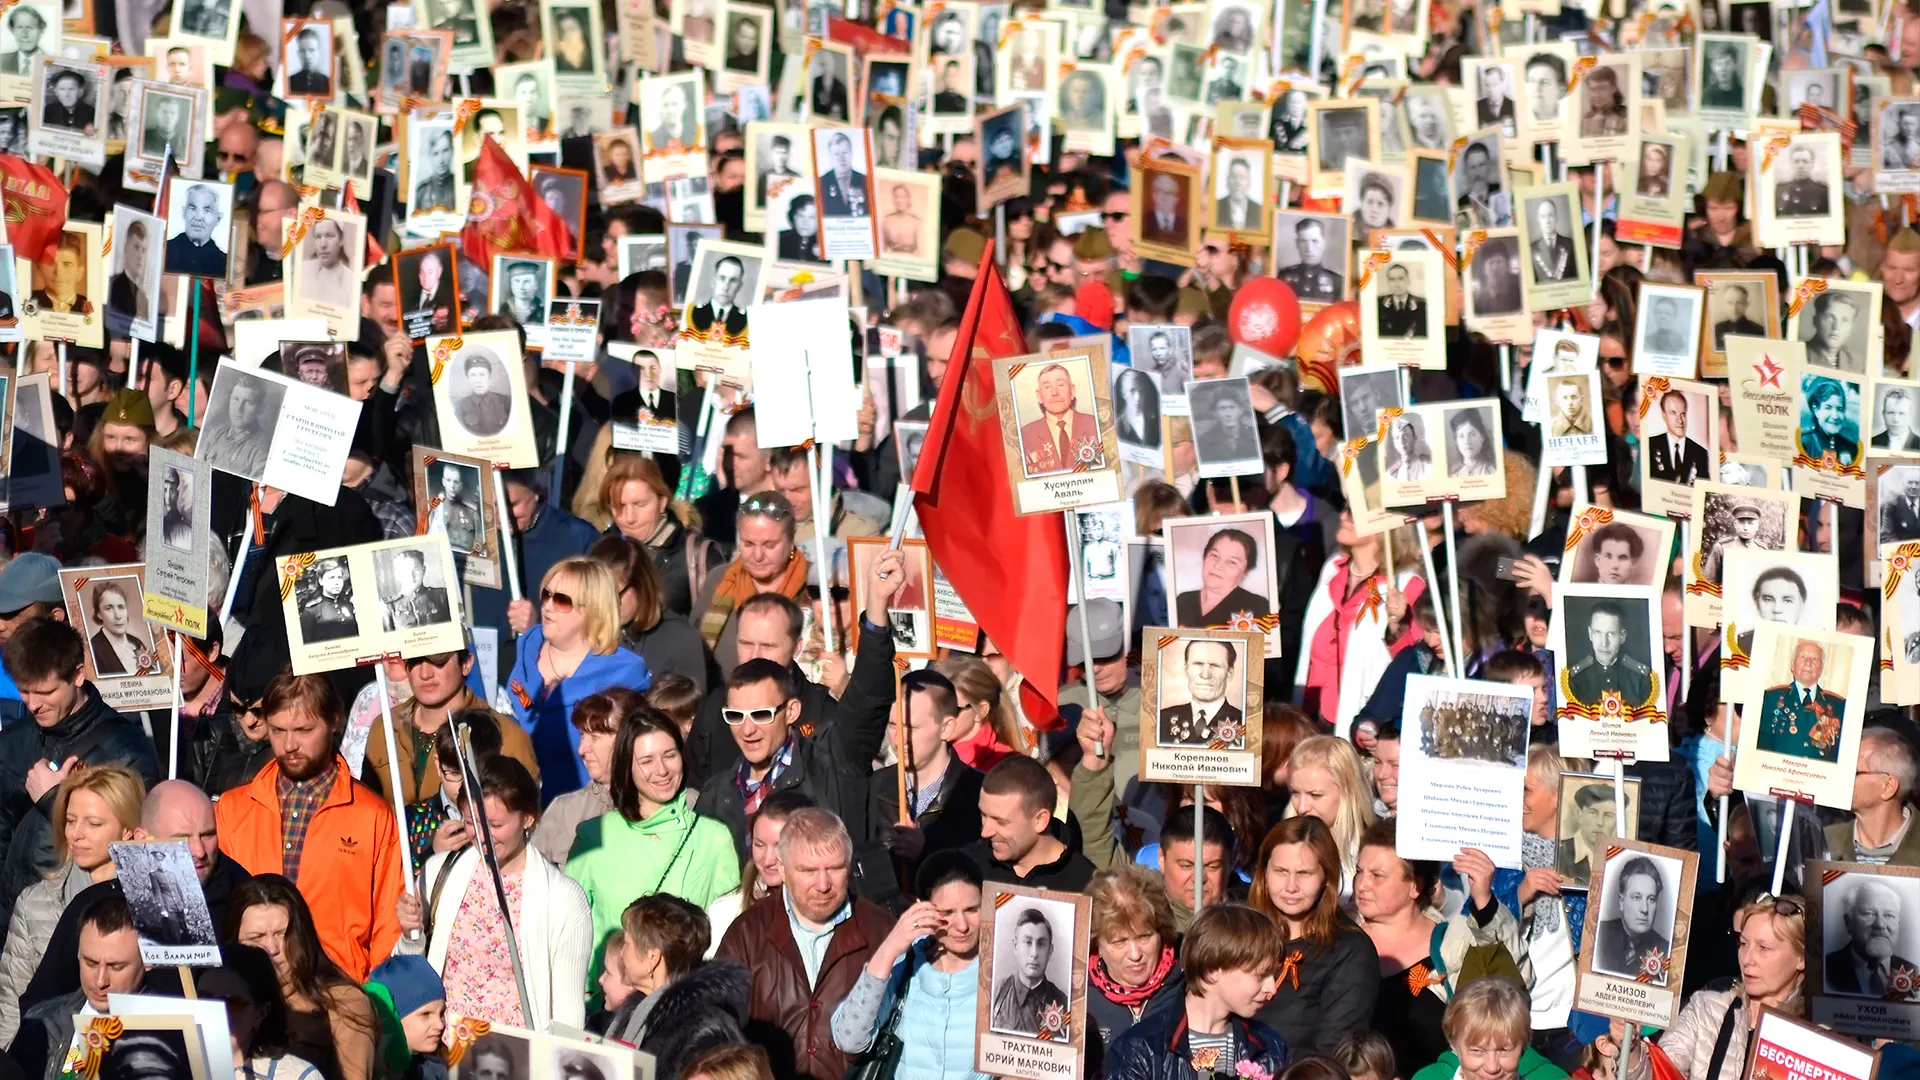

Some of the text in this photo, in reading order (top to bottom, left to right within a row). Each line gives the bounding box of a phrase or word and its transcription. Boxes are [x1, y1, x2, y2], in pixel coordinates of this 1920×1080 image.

[1756, 403, 1790, 417] ПОЛК
[1548, 436, 1599, 448] НЕЧАЕВ
[1043, 477, 1094, 491] Хуснуллин
[1054, 489, 1083, 499] Аваль
[120, 680, 143, 689] ЛЕВИНА
[124, 688, 172, 699] МИТРОФАНОВНА
[1174, 752, 1229, 764] Корепанов
[1151, 761, 1248, 774] Николай Иванович
[1761, 763, 1787, 774] Николай
[1606, 982, 1647, 999] ХАЗИЗОВ
[1594, 991, 1656, 1010] АВДЕЙ ЯКОВЛЕВИЧ
[1580, 997, 1670, 1021] РАБОТНИК БЛОКАДНОГО ЛЕНИНГРАДА
[1856, 1003, 1888, 1015] УХОВ
[1833, 1012, 1911, 1026] ИВАН ЮЛИАНОВИЧ
[1002, 1040, 1053, 1057] ТРАХТМАН
[985, 1052, 1072, 1075] ЮРИЙ МАРКОВИЧ
[1015, 1068, 1040, 1078] КАПИТАН
